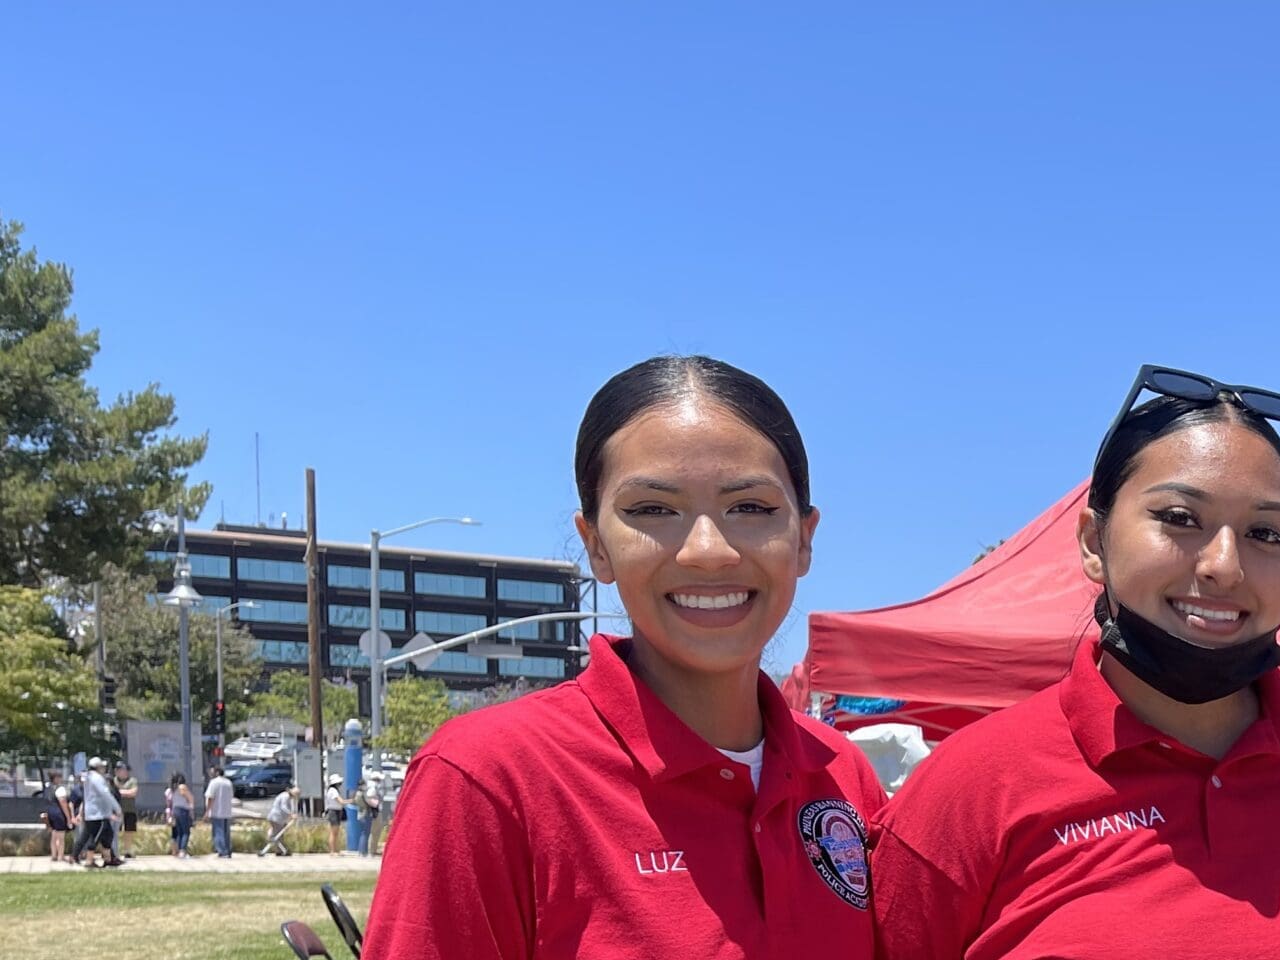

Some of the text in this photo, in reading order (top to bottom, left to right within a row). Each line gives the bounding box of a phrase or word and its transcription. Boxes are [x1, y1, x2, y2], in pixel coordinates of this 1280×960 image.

[1054, 806, 1165, 845] VIVIANNA
[635, 851, 688, 874] LUZ
[818, 864, 845, 896] POLICE
